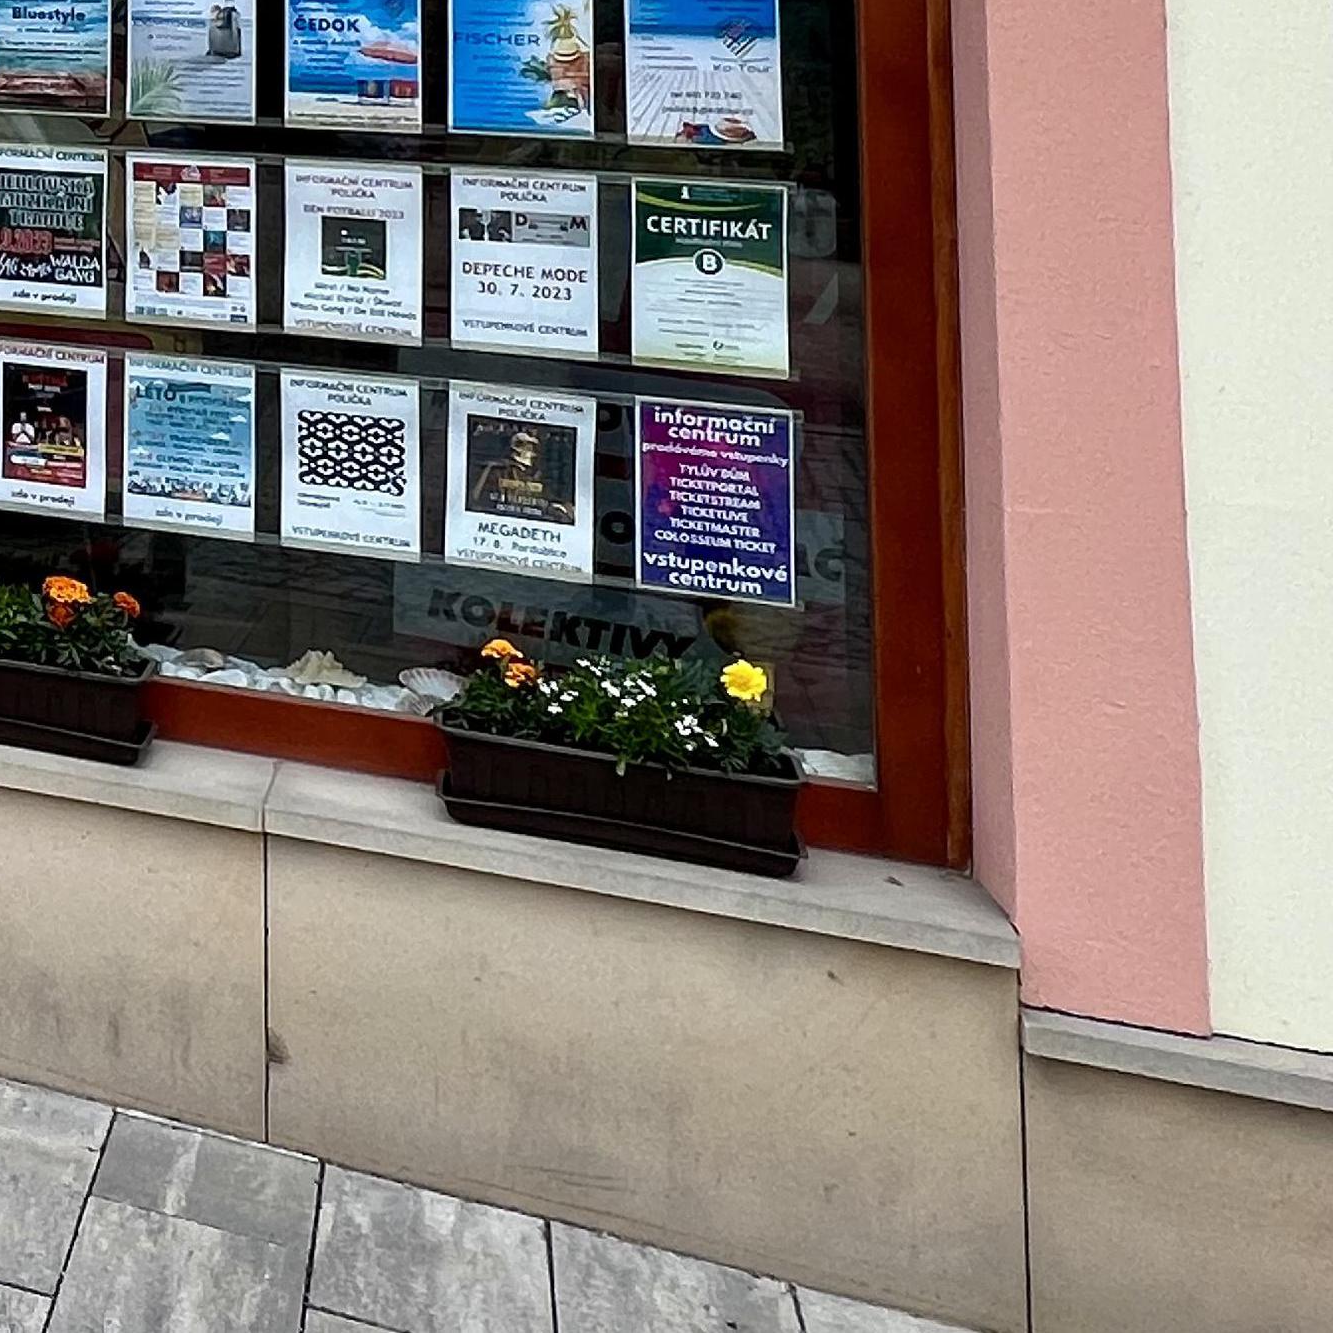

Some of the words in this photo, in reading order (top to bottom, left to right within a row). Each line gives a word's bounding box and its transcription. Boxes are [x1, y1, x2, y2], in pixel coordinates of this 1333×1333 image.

[11, 5, 87, 25] Bluestyle
[292, 14, 361, 33] ČEDOK
[452, 30, 541, 47] FISCHER
[645, 214, 773, 240] CERTIFIKÁT
[461, 260, 536, 280] DEPECHE
[540, 267, 589, 284] MODE
[701, 253, 719, 273] B
[54, 267, 96, 283] GANG
[531, 284, 573, 301] 2023
[652, 405, 776, 435] informační
[667, 426, 762, 448] centrum
[719, 450, 791, 468] vstupenky
[668, 475, 760, 497] TICKETPORTAL
[668, 489, 762, 510] TICKETSTREAM
[679, 503, 750, 523] TICKETLIVE
[476, 521, 562, 543] MEGADETH
[668, 516, 761, 538] TICKETMASTER
[653, 528, 732, 549] COLOSSEUM
[733, 538, 777, 555] TICKET
[641, 550, 789, 583] vstupenkové
[667, 570, 763, 596] centrum
